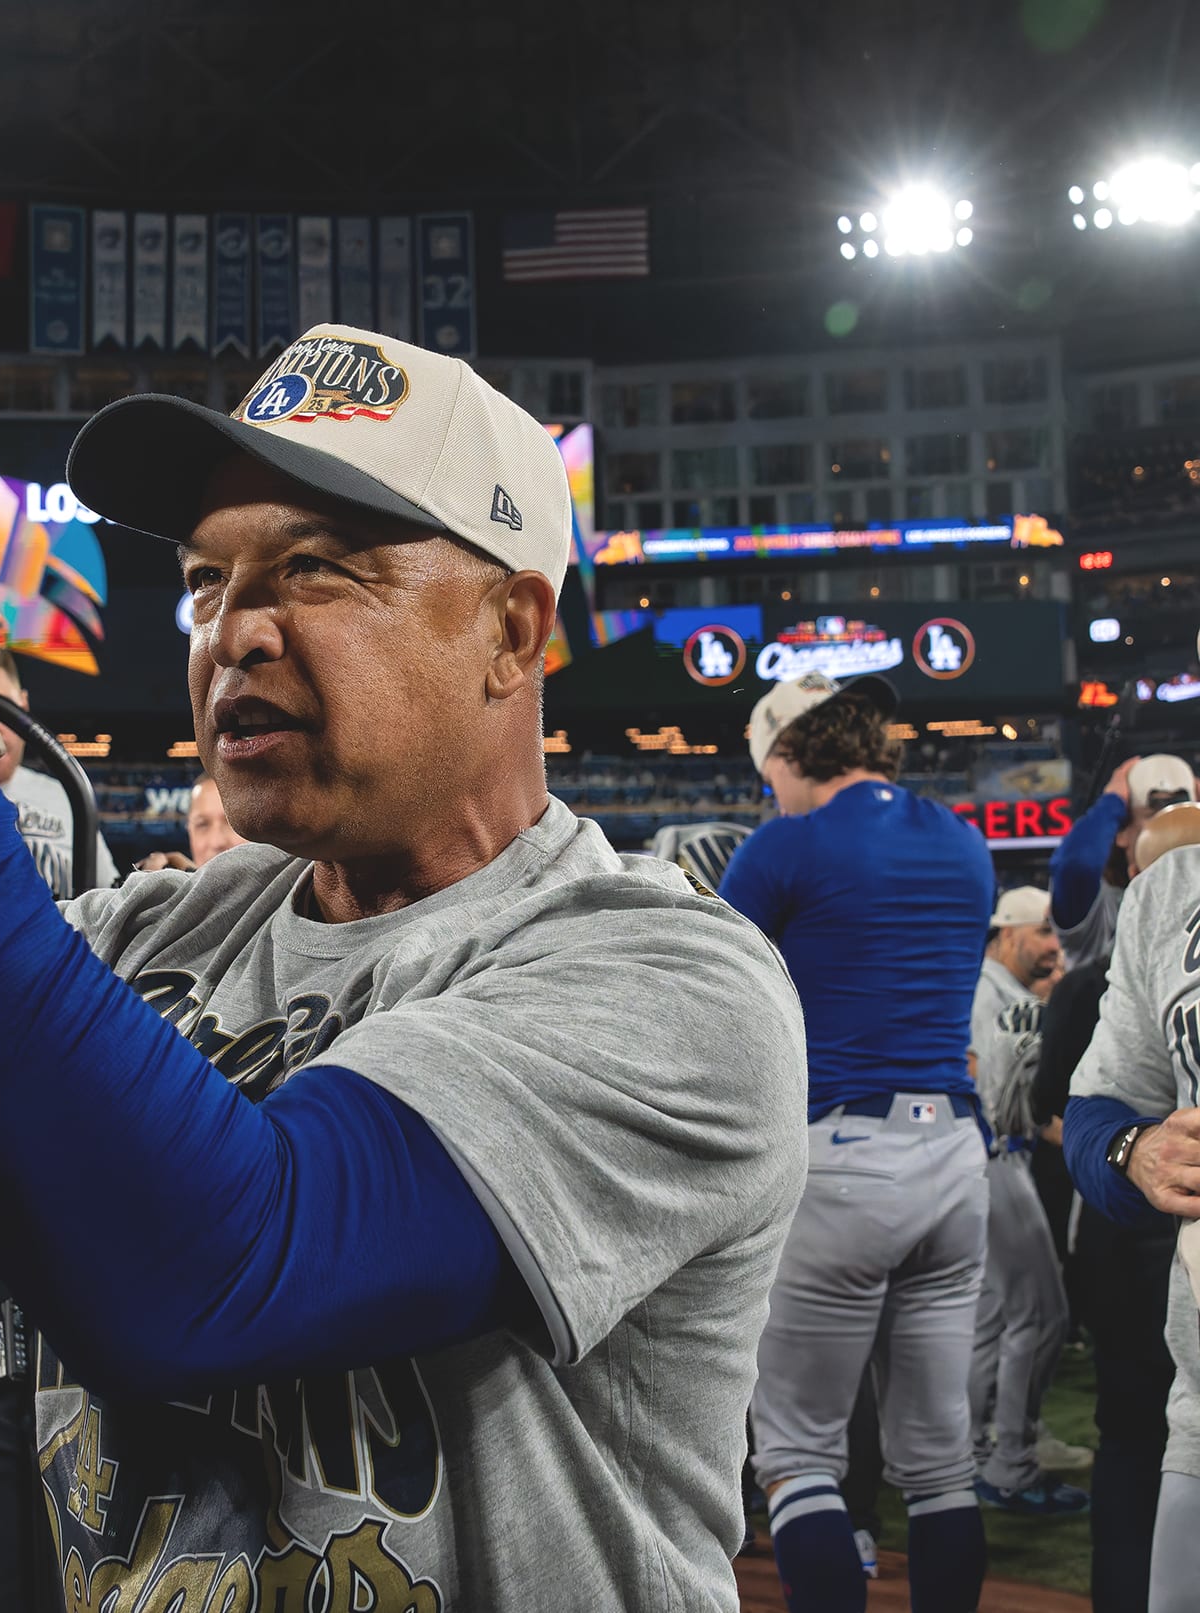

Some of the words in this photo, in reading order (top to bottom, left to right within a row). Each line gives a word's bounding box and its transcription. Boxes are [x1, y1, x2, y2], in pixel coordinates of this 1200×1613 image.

[255, 382, 291, 416] LA
[308, 399, 323, 411] 25
[698, 631, 733, 677] LA
[927, 625, 961, 670] LA
